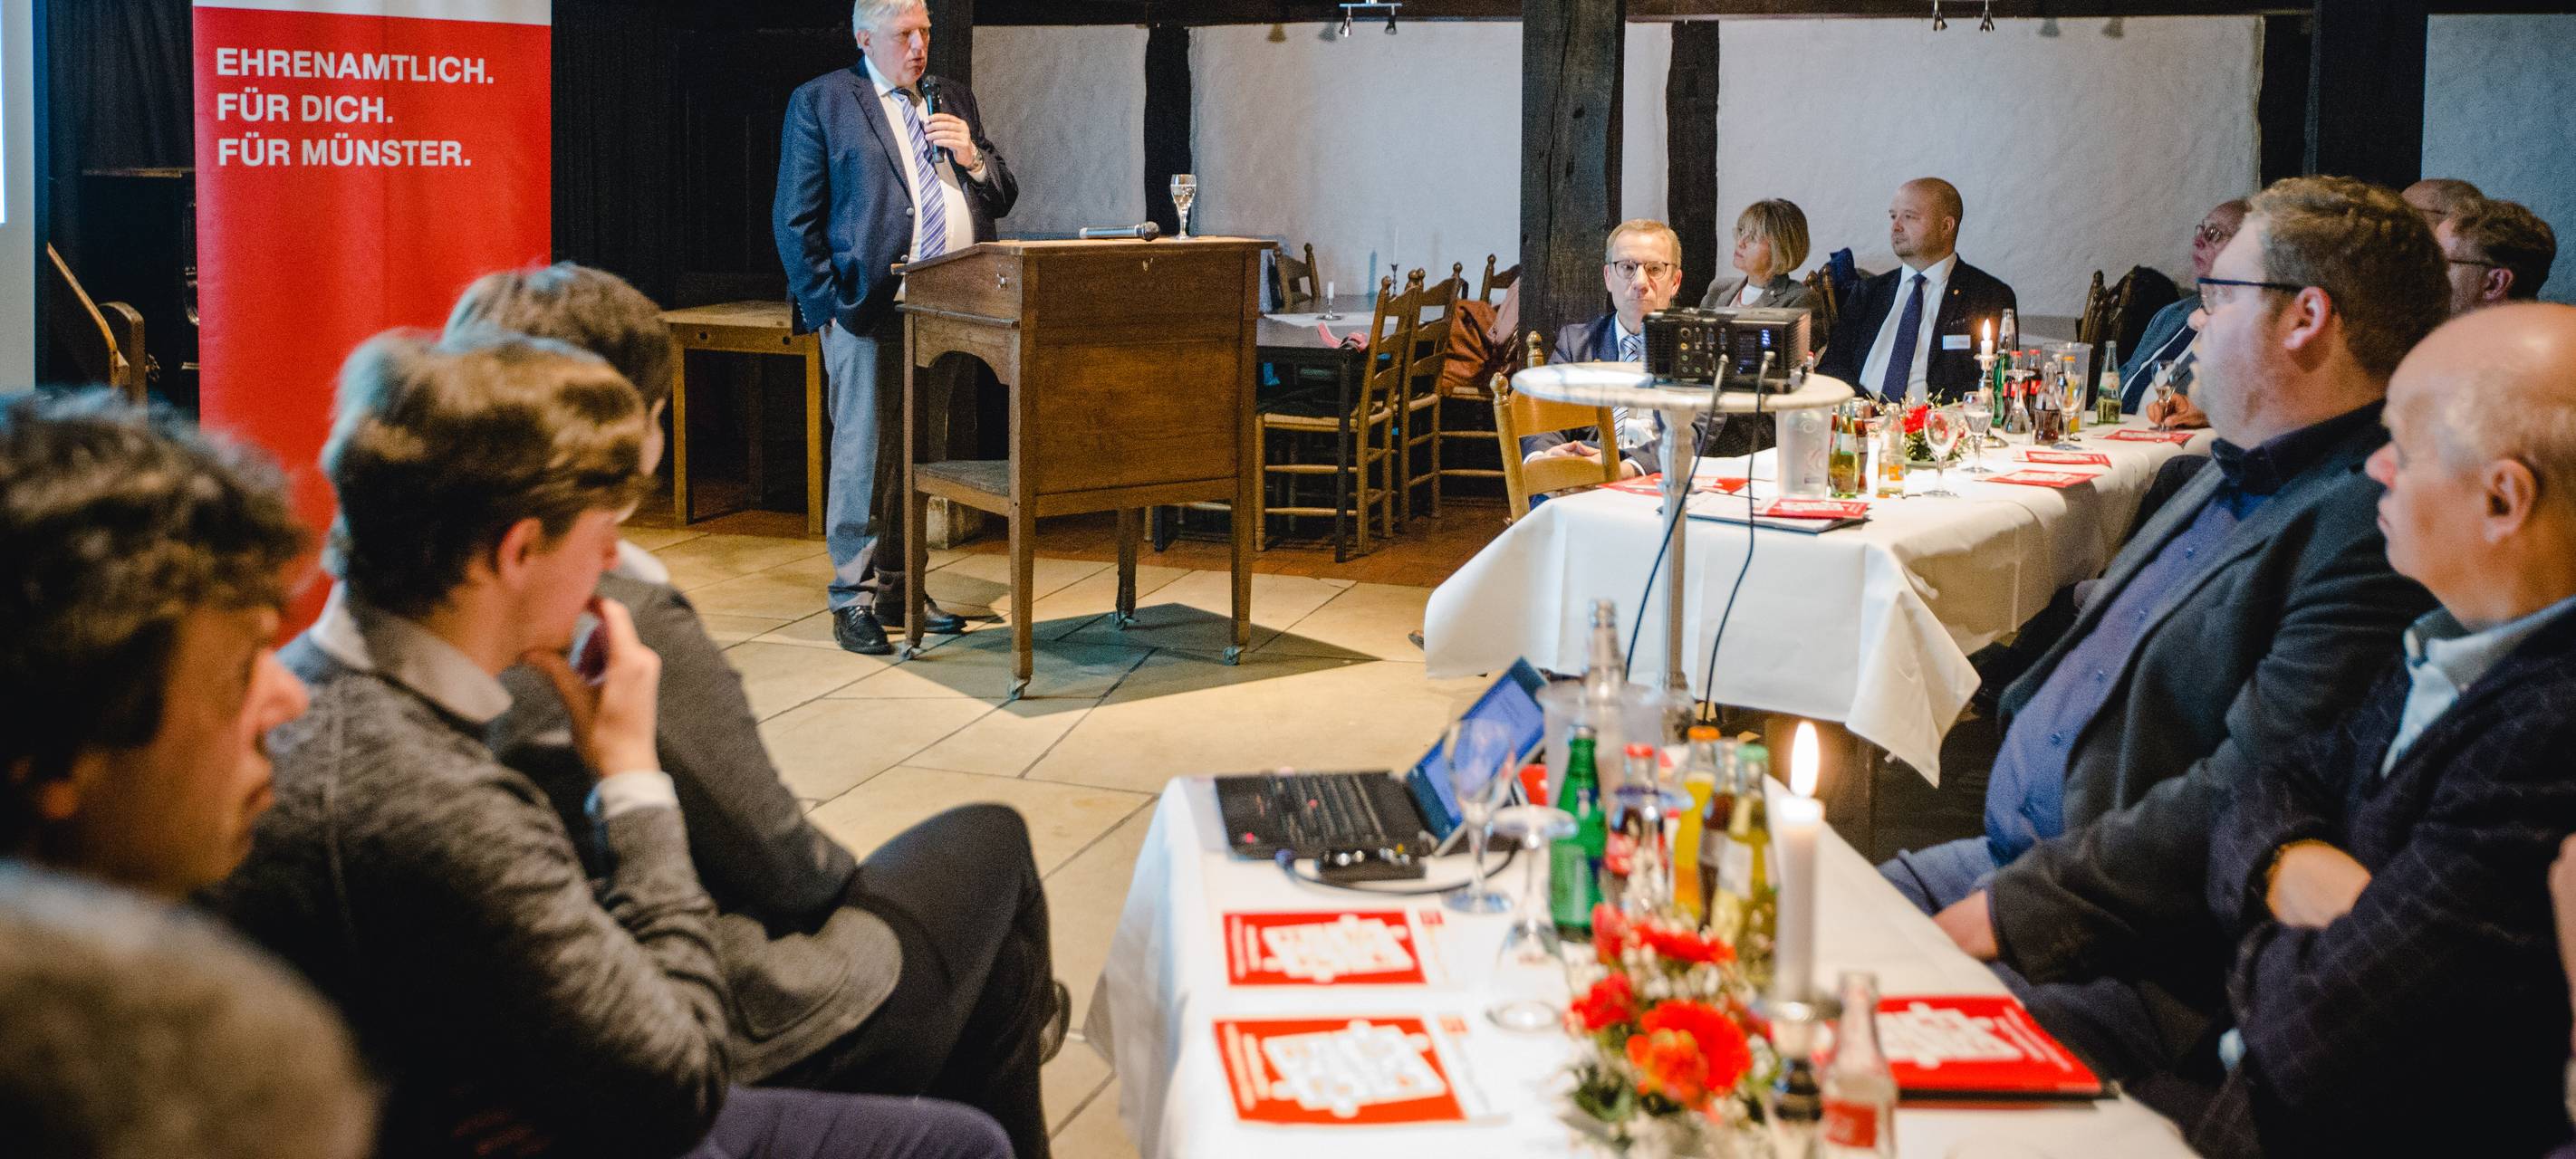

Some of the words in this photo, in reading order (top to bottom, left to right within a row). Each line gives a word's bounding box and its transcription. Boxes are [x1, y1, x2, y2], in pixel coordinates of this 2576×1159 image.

[216, 48, 494, 84] EHRENAMTLICH.
[216, 87, 290, 122] FÜR
[302, 95, 393, 124] DICH.
[218, 132, 290, 167] FÜR
[302, 132, 471, 167] MÜNSTER.
